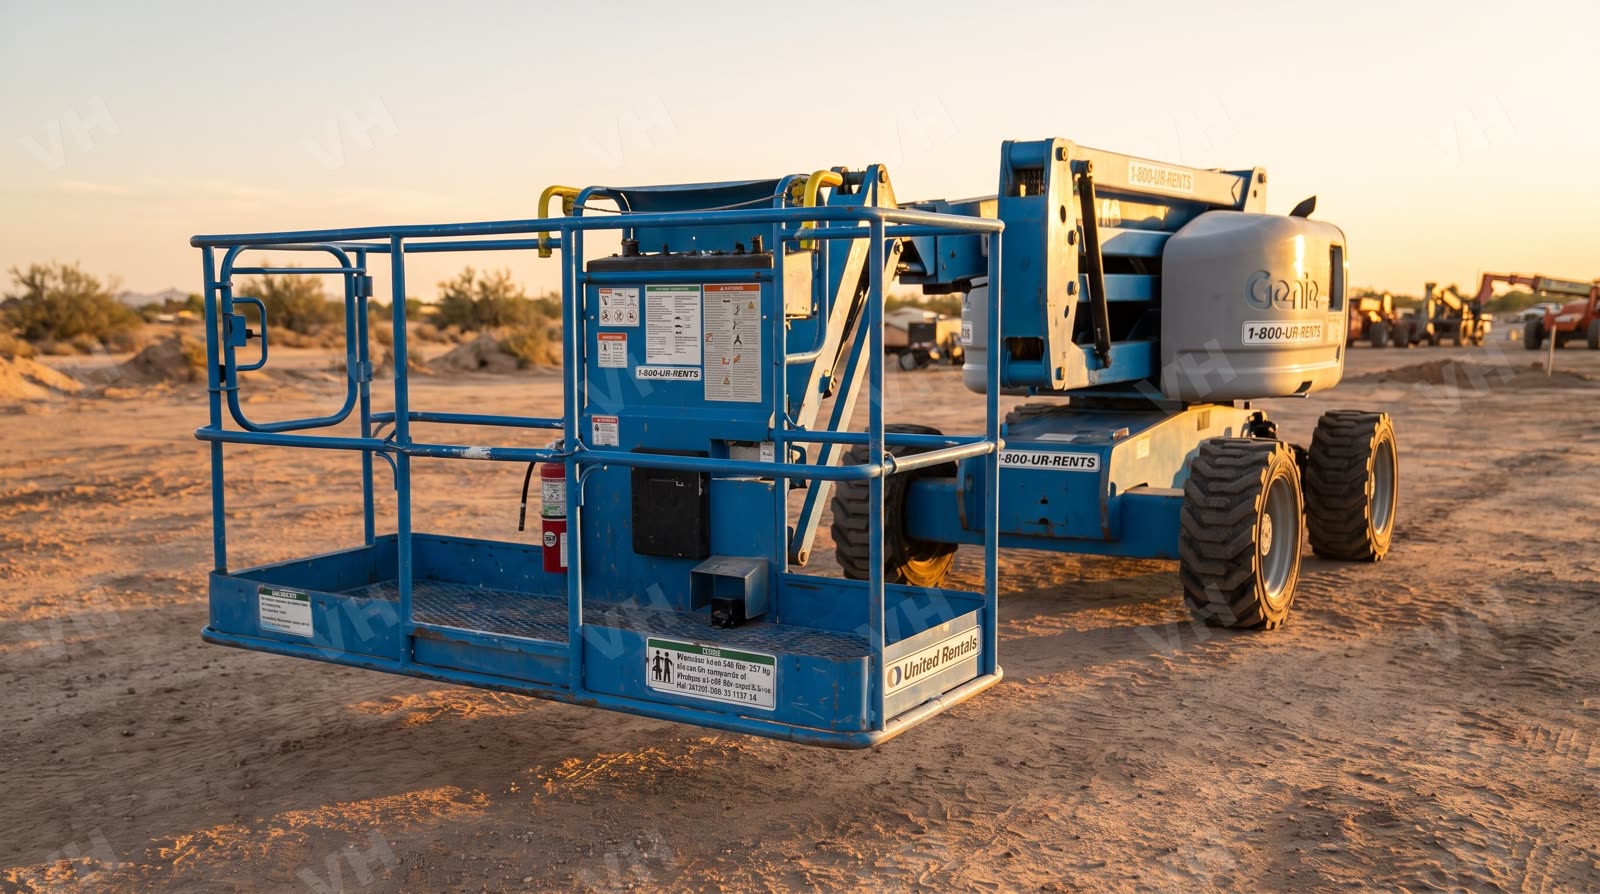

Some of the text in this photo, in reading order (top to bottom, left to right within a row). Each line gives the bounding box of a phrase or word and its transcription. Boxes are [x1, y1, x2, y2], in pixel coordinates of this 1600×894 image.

[1131, 166, 1192, 190] 1-800-UR-RENTS
[1244, 269, 1319, 311] Genie
[1248, 326, 1321, 340] 1-800-UR-RENTS
[638, 369, 699, 378] 1-800-UR-RENTS
[904, 635, 977, 680] United Rentals
[749, 664, 760, 673] 257
